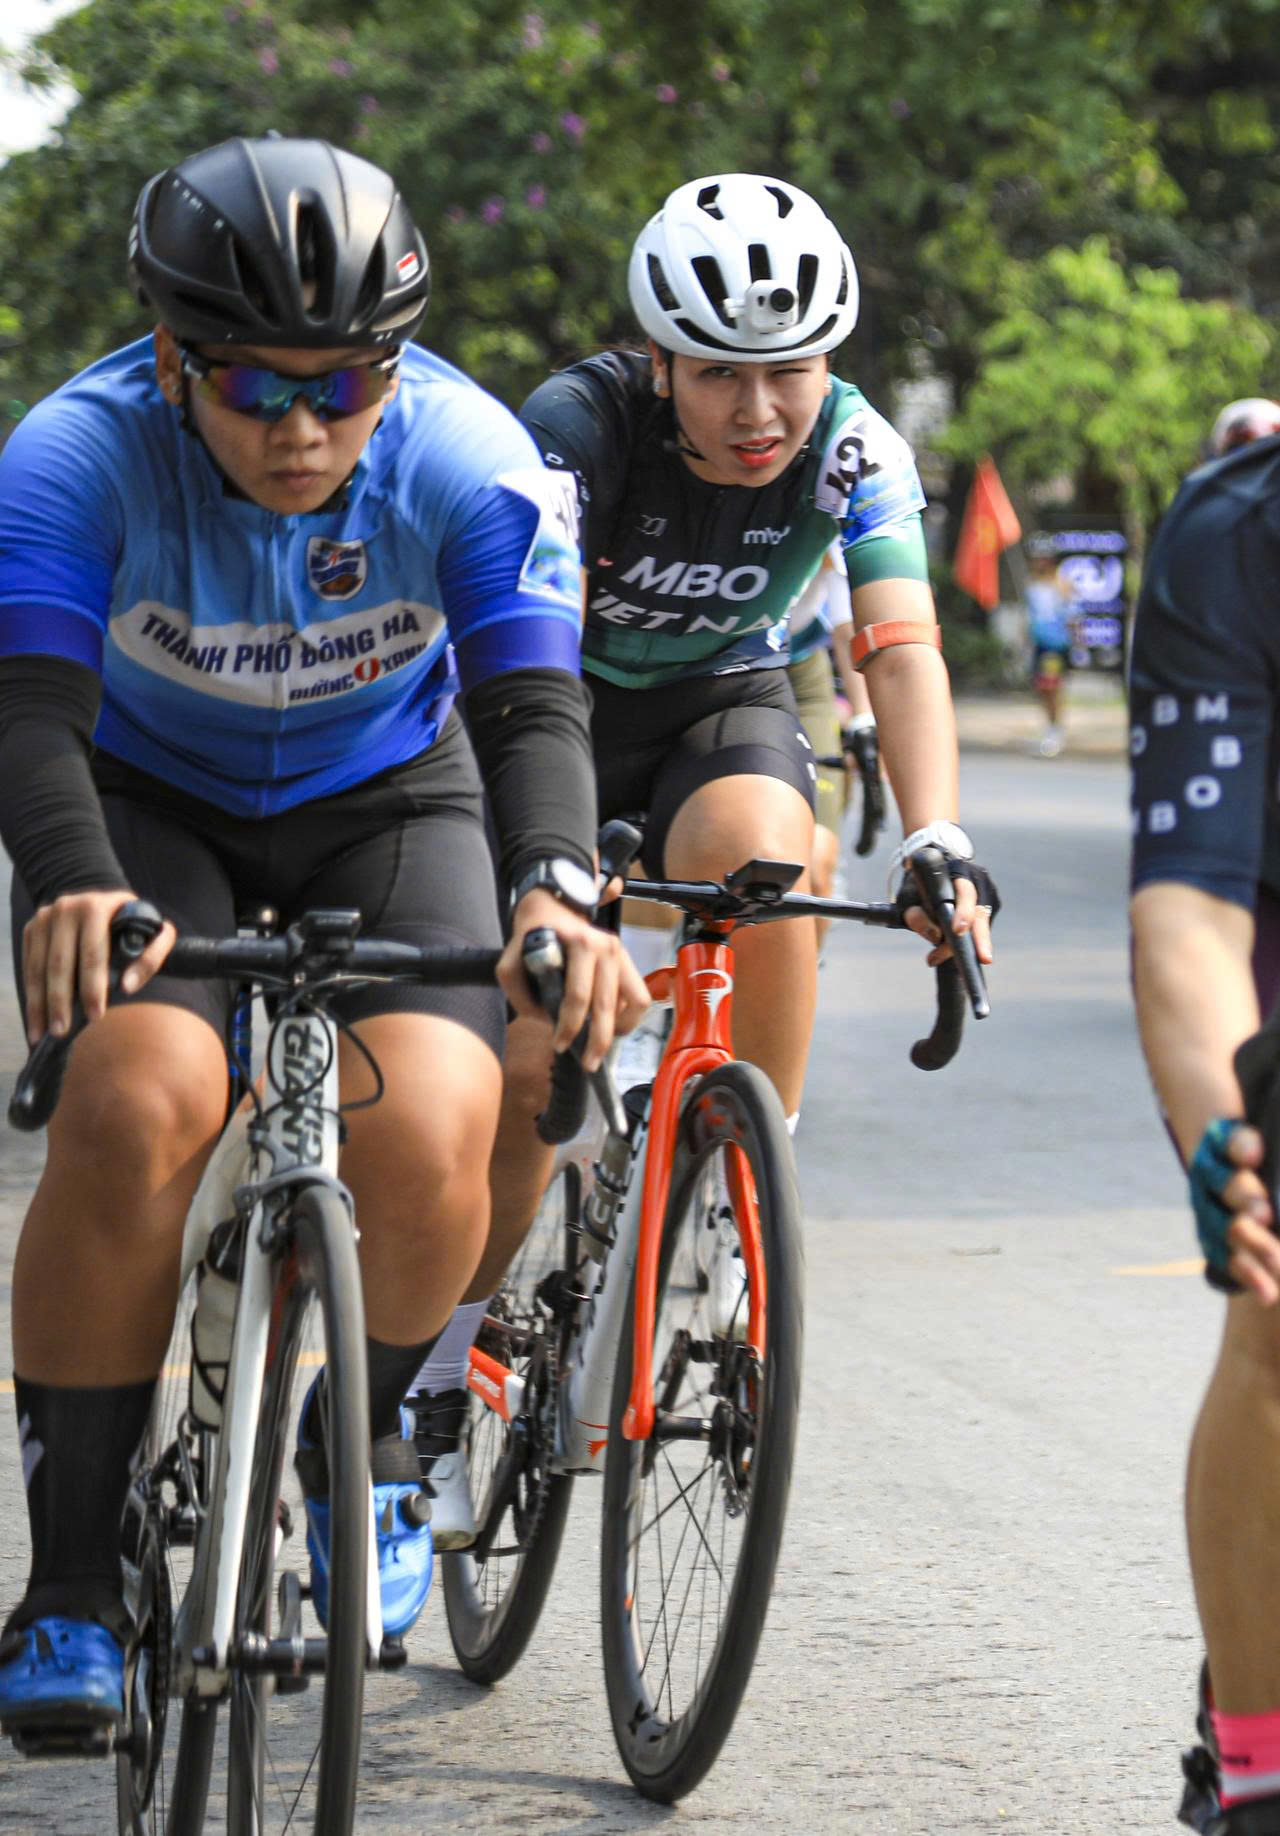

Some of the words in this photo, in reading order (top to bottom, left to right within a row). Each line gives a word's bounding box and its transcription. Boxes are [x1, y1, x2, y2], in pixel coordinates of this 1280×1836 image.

[619, 556, 769, 601] MBO
[382, 609, 421, 642] HÀ
[590, 587, 684, 629] IET
[353, 657, 381, 683] 9
